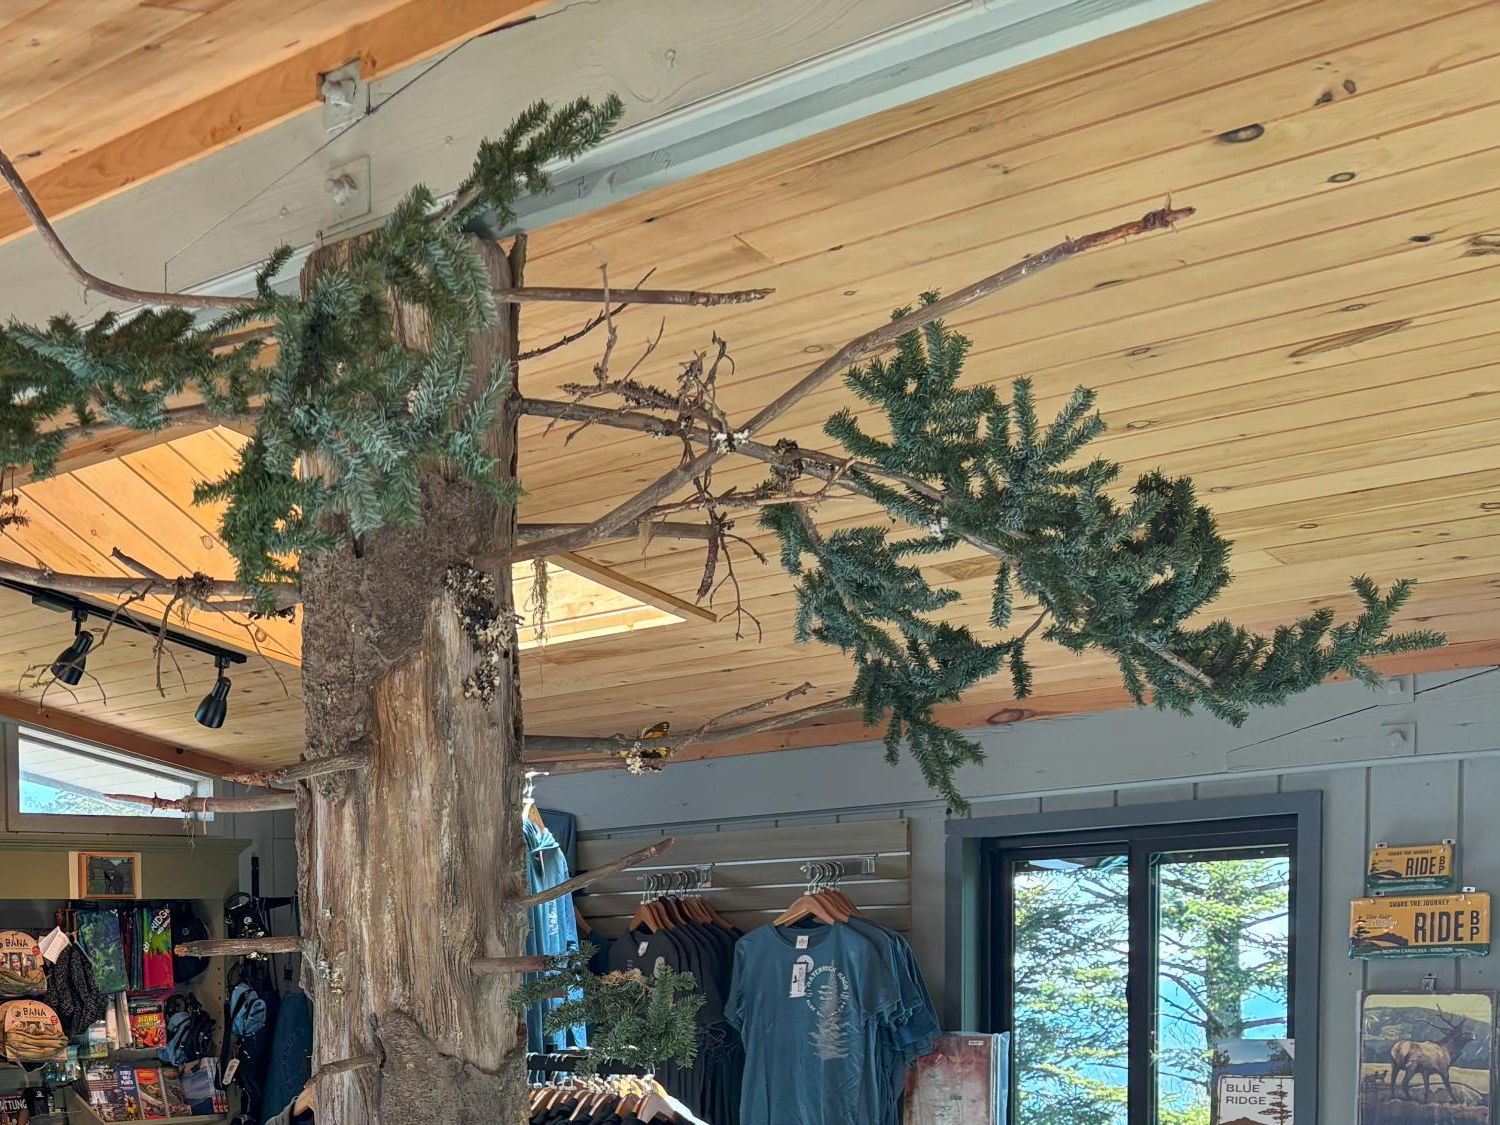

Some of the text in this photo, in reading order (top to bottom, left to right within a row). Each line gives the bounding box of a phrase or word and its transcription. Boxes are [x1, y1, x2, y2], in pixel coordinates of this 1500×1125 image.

[1439, 856, 1445, 864] B
[1405, 857, 1436, 876] RIDE
[1470, 910, 1480, 925] B
[1414, 911, 1464, 943] RIDE
[1470, 927, 1479, 941] P
[5, 939, 28, 947] BANA
[23, 1008, 46, 1016] BANA
[1226, 1084, 1260, 1093] BLUE
[1226, 1096, 1266, 1105] RIDGE
